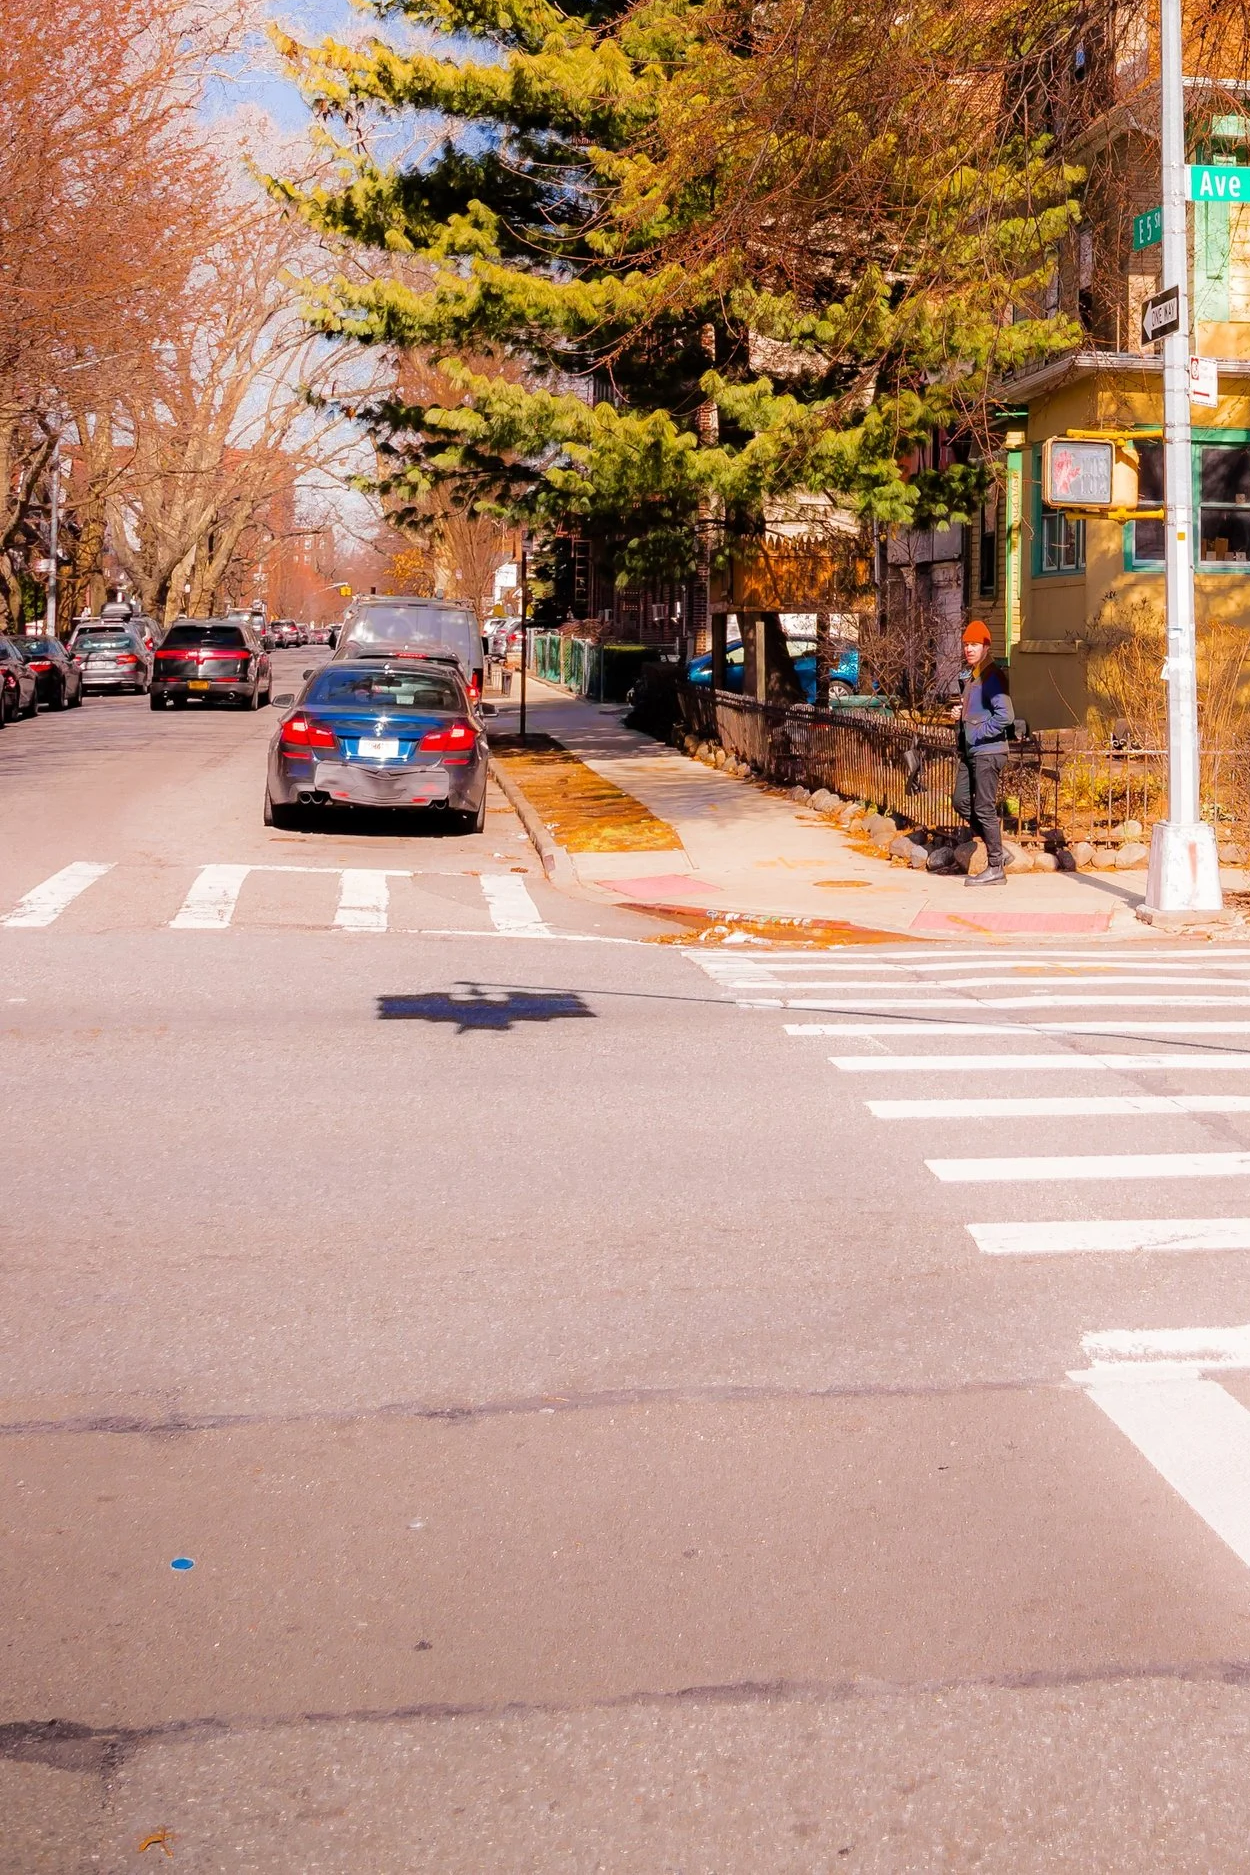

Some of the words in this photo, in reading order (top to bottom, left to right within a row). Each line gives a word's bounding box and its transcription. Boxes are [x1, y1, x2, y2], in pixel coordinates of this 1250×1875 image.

[1199, 170, 1241, 198] Ave
[1139, 219, 1144, 244] E
[1146, 215, 1152, 241] 5
[1152, 306, 1162, 328] ONE
[1163, 298, 1176, 323] WAY
